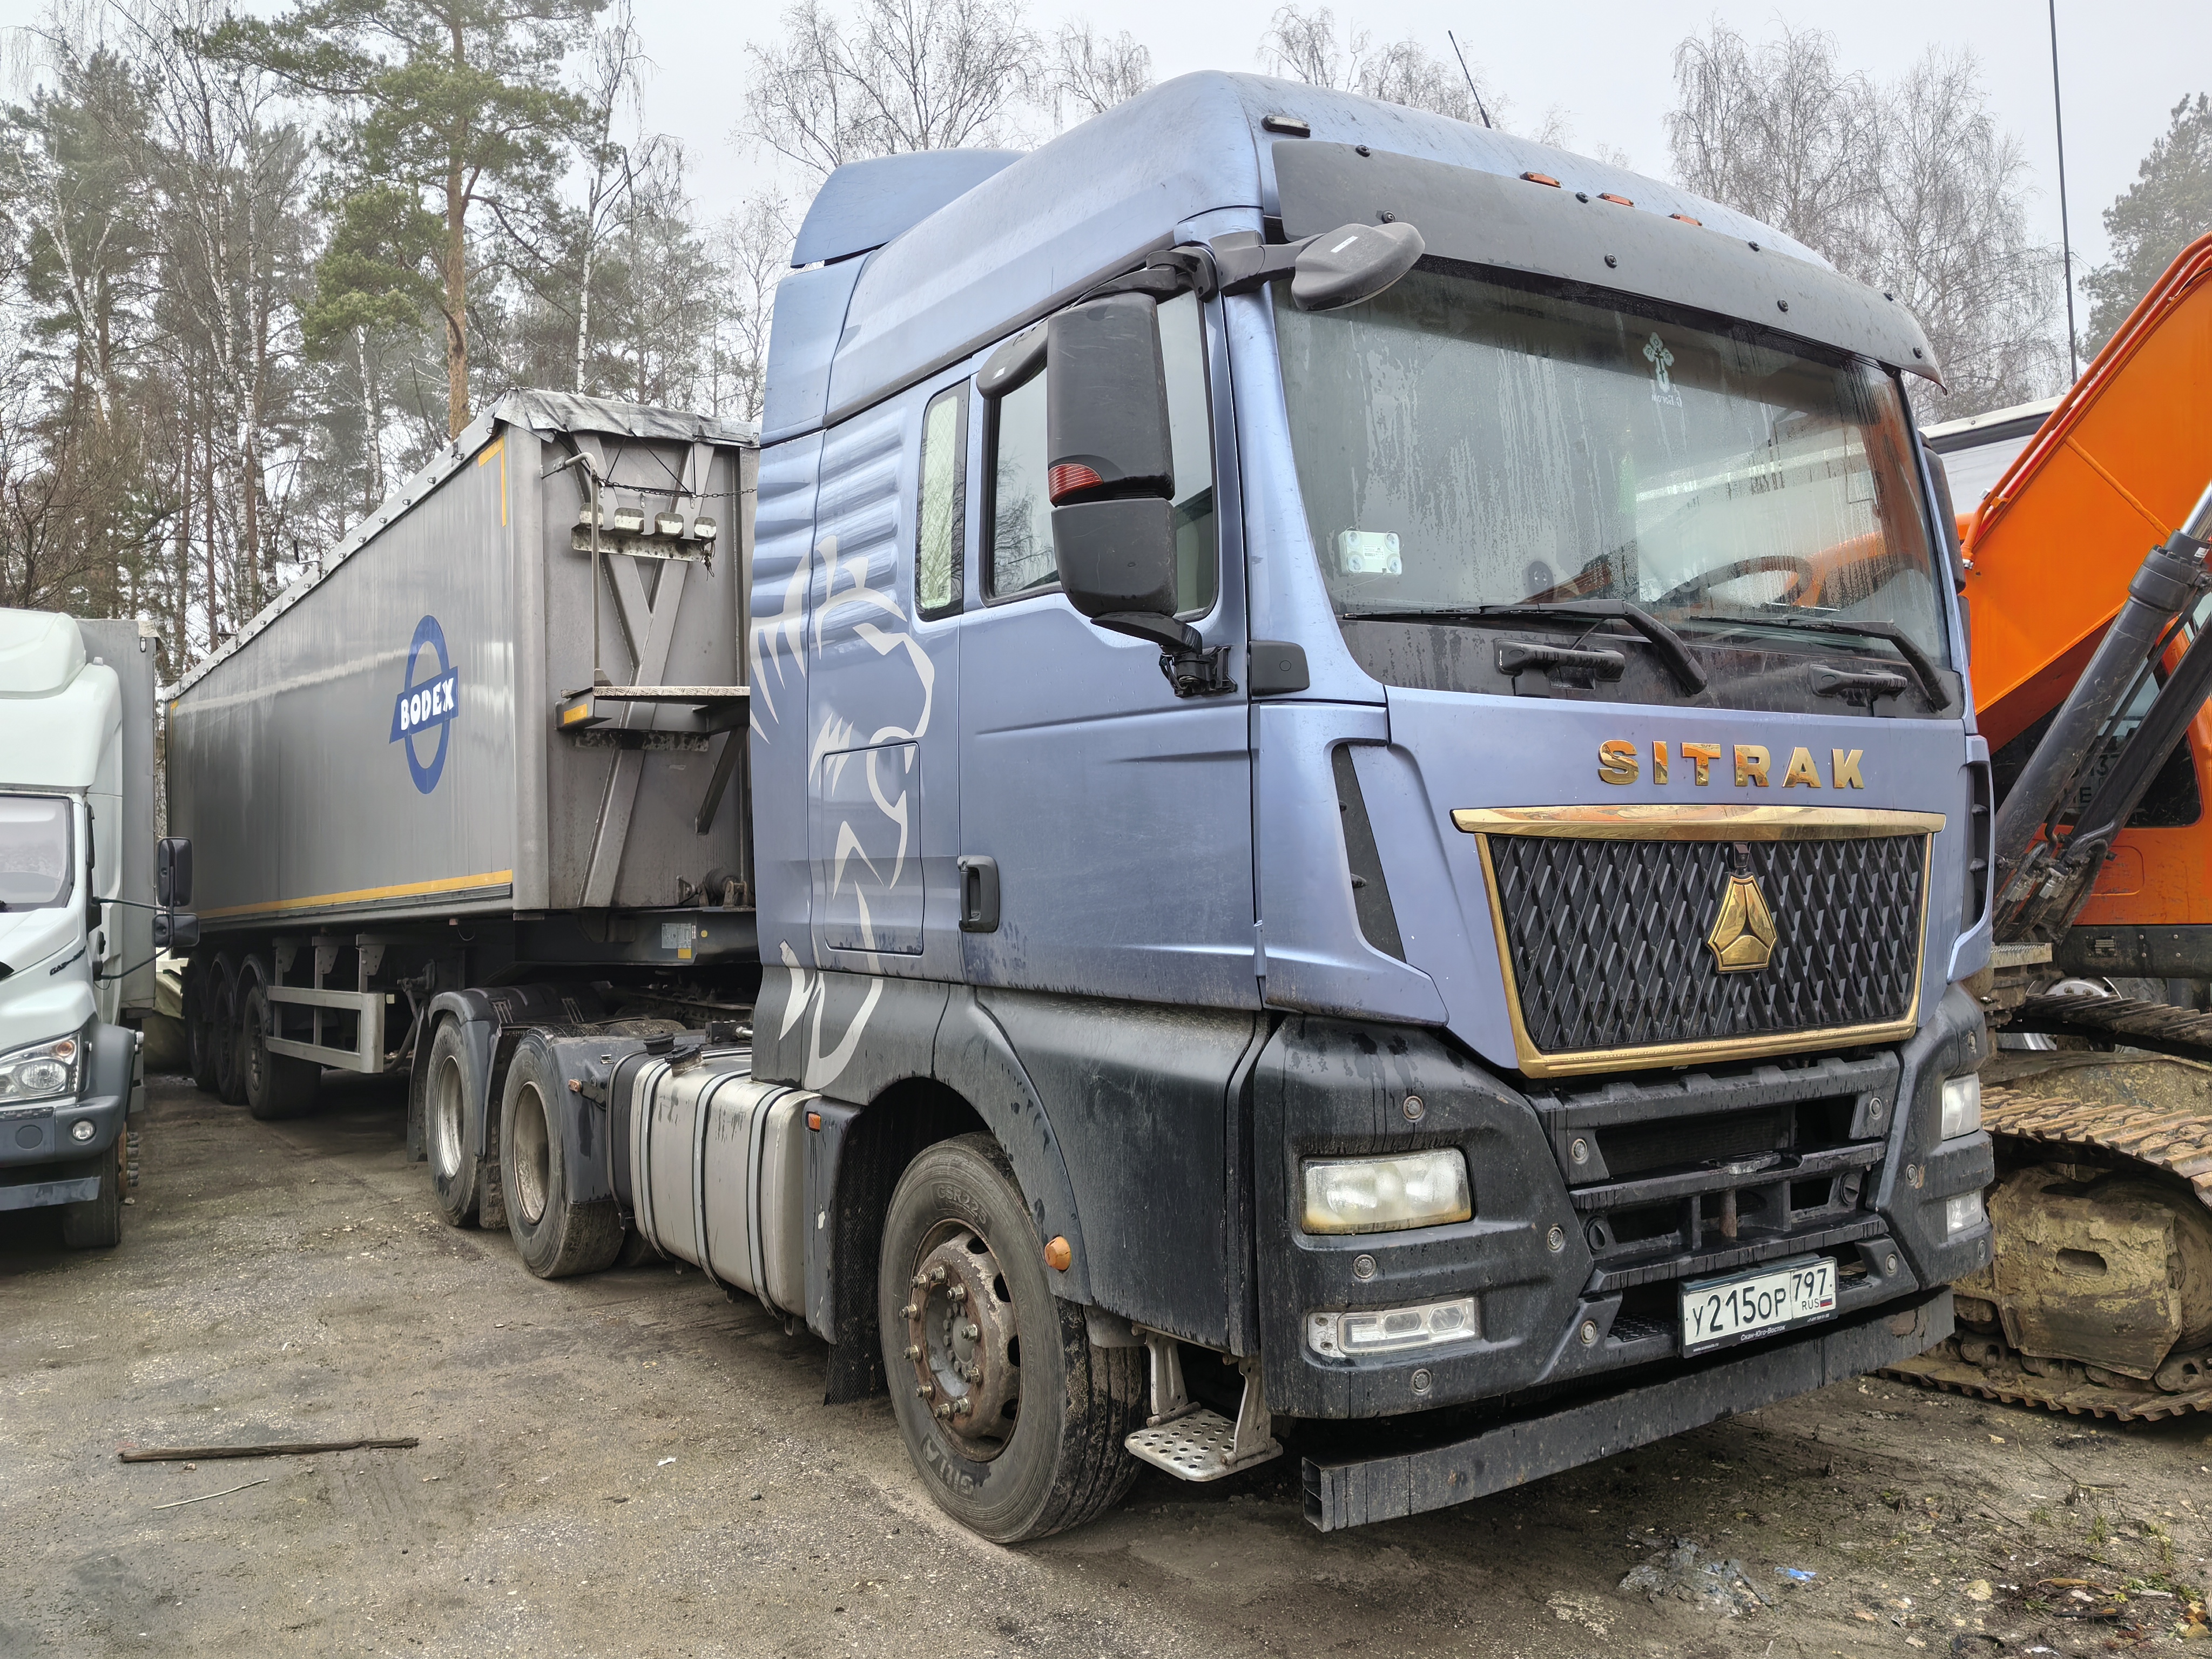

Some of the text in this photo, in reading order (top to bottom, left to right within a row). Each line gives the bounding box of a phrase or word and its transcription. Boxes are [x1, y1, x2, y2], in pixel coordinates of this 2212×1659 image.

[401, 677, 454, 731] BODEX
[1597, 739, 1866, 789] SITRAK
[1792, 1267, 1827, 1302] 797
[1802, 1298, 1820, 1311] RUS
[1741, 1324, 1786, 1341] Скан-Юго-Восток
